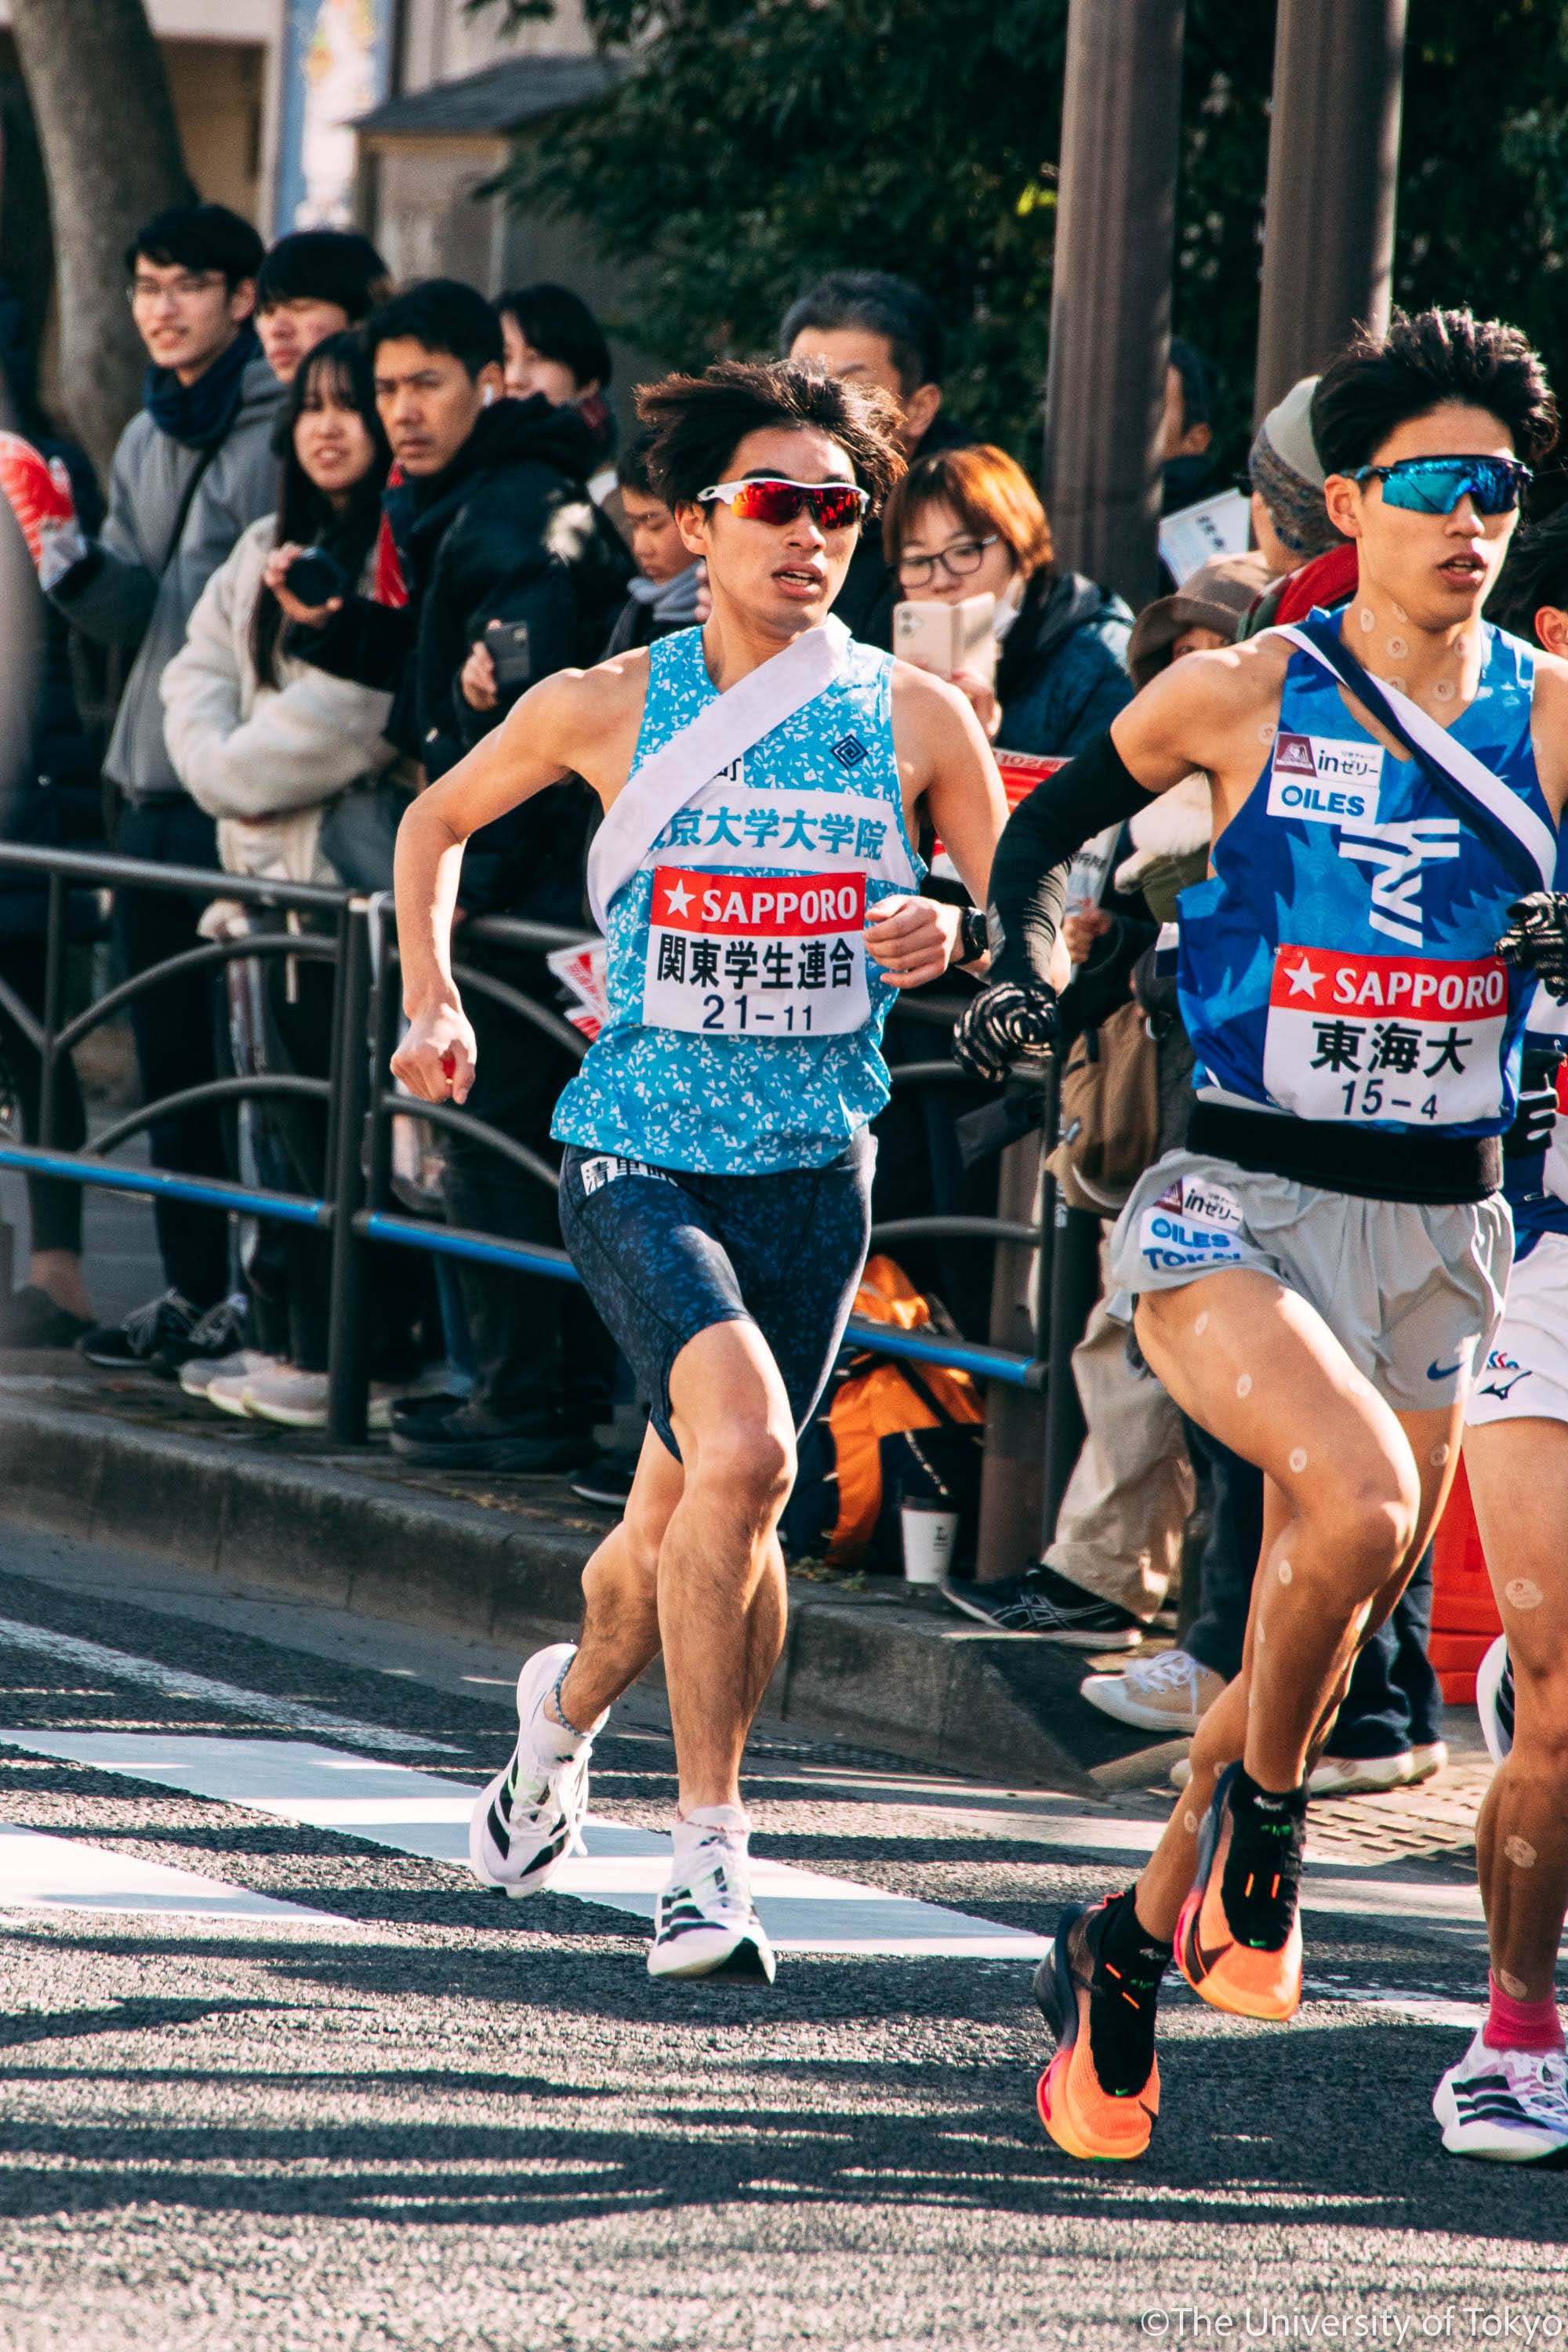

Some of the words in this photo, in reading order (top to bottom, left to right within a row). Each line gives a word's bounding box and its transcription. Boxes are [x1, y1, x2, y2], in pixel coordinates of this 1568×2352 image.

[1281, 785, 1365, 817] OILES
[650, 806, 887, 860] 京大学大学院
[701, 886, 858, 924] SAPPORO
[657, 933, 855, 990] 関東学生連合
[1333, 967, 1504, 1011] SAPPORO
[702, 993, 812, 1031] 21-11
[1309, 1019, 1473, 1078] 東海大
[1341, 1079, 1438, 1120] 15-4
[1151, 1218, 1231, 1248] OILES
